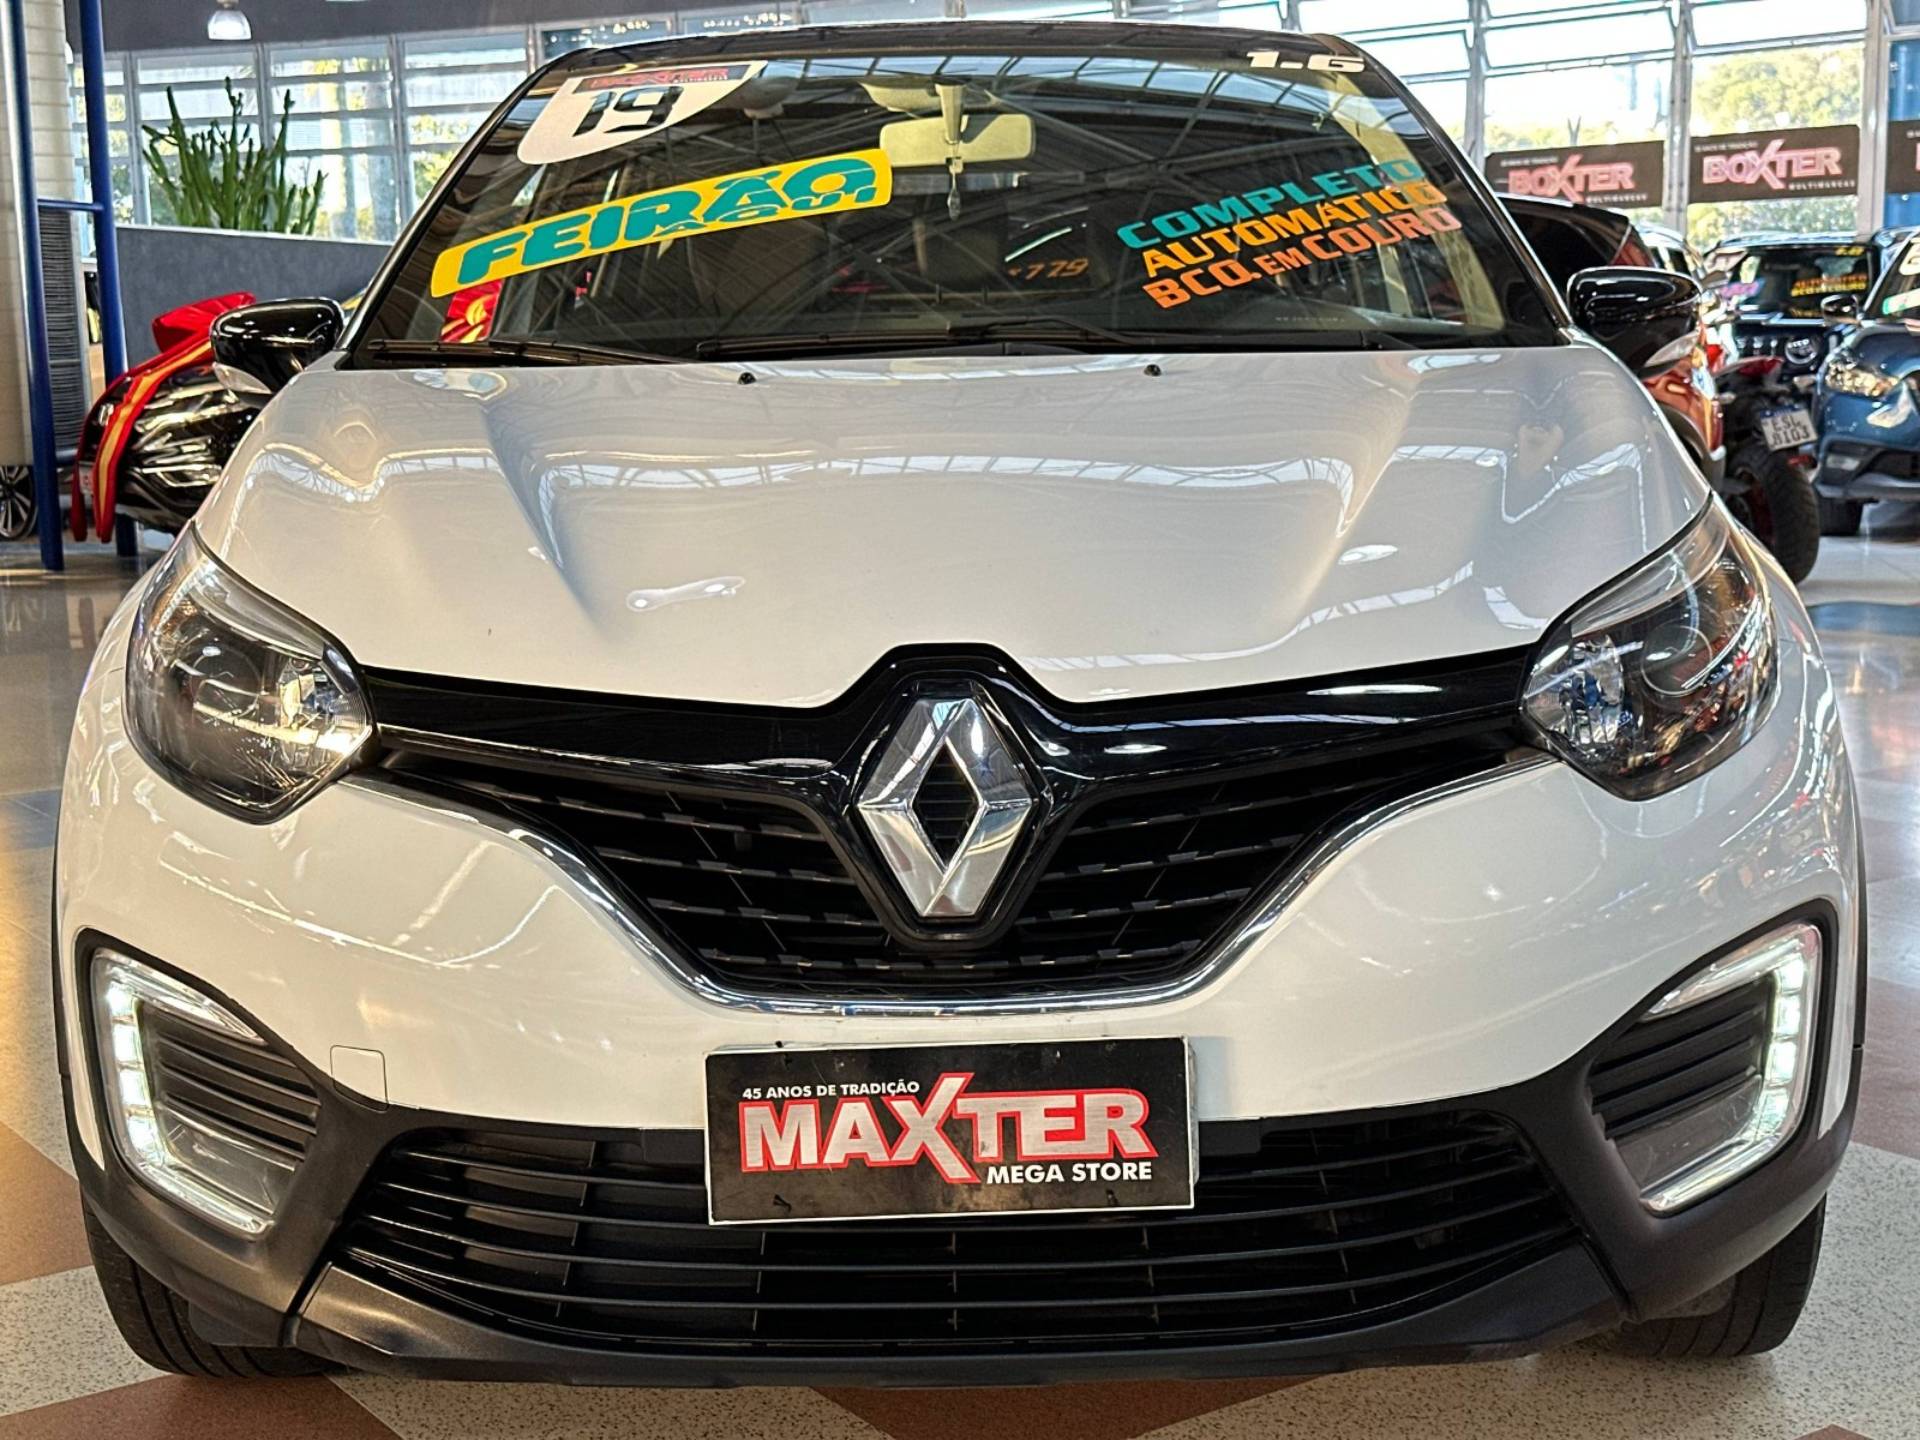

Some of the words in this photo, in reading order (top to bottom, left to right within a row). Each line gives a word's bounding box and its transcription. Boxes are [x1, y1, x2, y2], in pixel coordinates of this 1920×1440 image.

[1247, 51, 1365, 72] 1.6
[573, 86, 684, 137] 19
[1508, 154, 1635, 203] BOXTER
[1703, 139, 1842, 189] BOXTER
[457, 158, 876, 285] FEIRÃO
[1117, 160, 1425, 248] COMPLETO
[1253, 247, 1312, 275] EM
[1301, 207, 1462, 260] COURO
[743, 1087, 762, 1100] 45
[767, 1085, 814, 1099] ANOS
[817, 1084, 837, 1098] DE
[841, 1079, 920, 1098] TRADIÇÃO
[739, 1073, 1159, 1184] MAXTER
[986, 1165, 1064, 1185] MEGA
[1072, 1162, 1152, 1182] STORE
